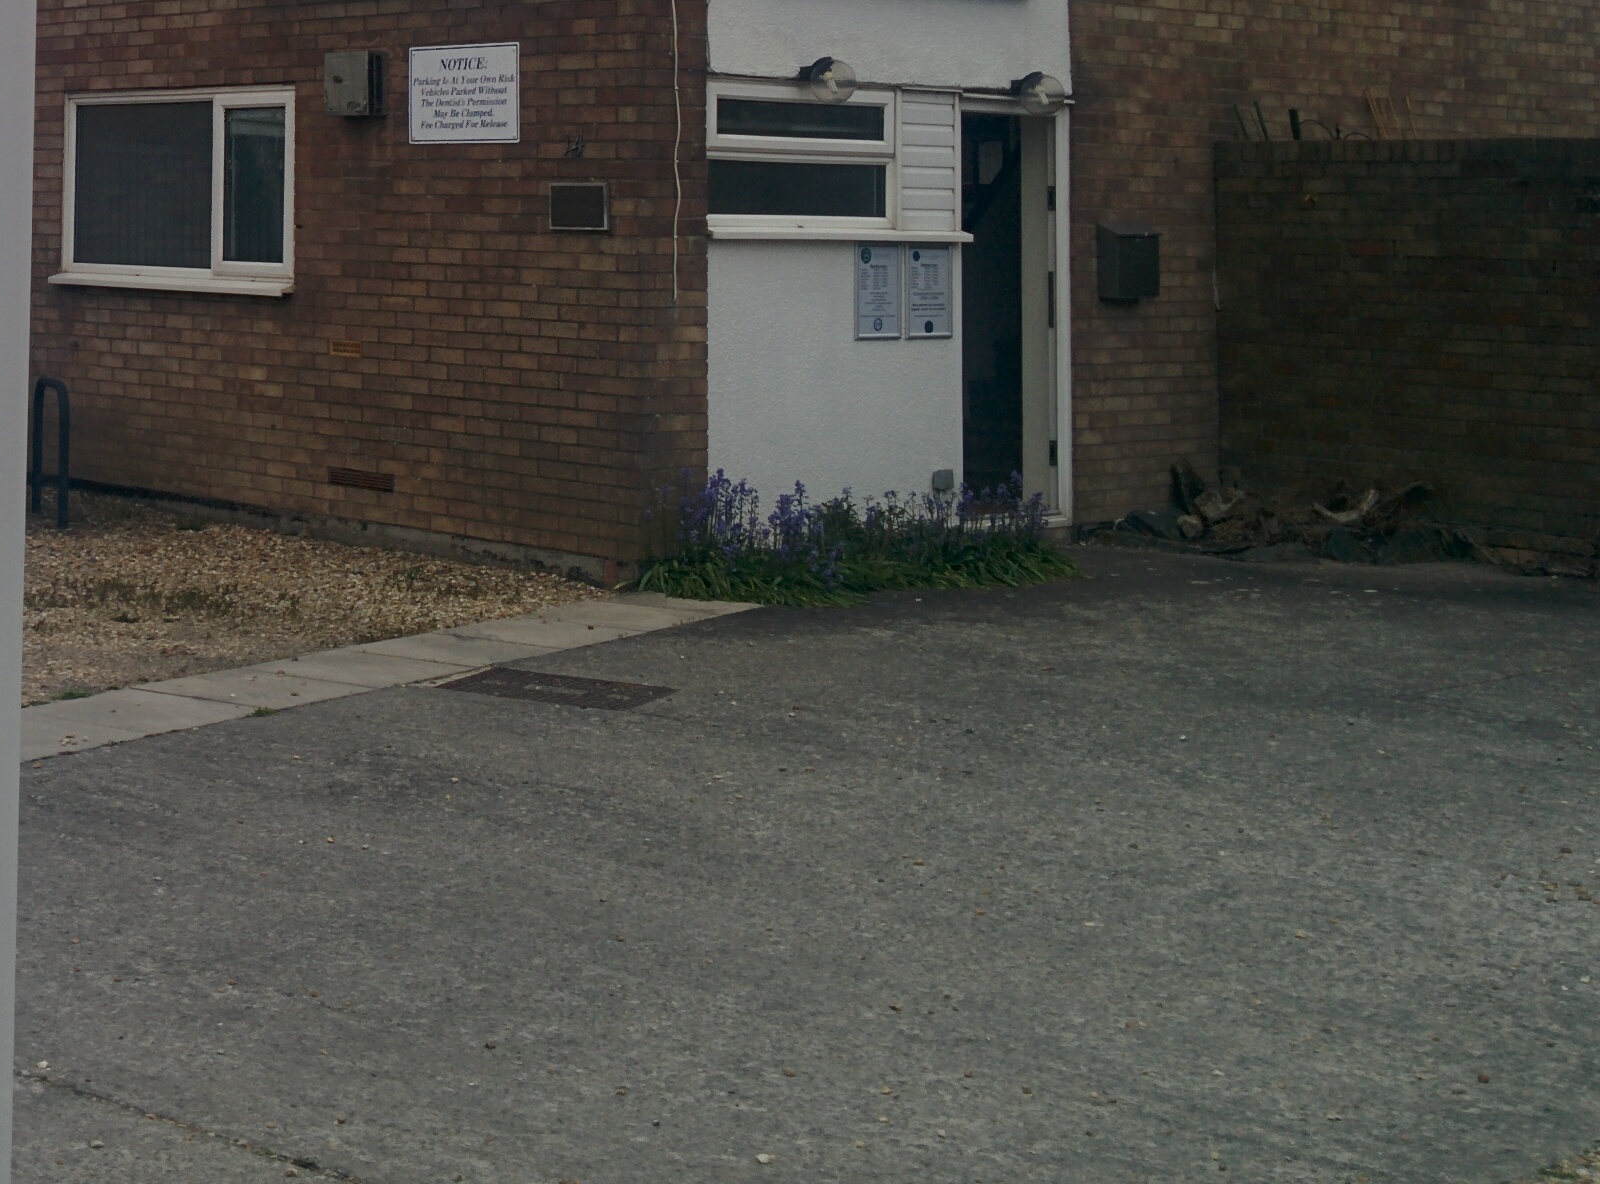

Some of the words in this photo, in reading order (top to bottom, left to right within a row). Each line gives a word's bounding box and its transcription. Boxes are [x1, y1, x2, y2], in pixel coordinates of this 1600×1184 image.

[439, 57, 488, 72] NOTICE:
[413, 77, 441, 86] Parking
[442, 76, 448, 85] Is
[450, 76, 458, 85] At
[461, 75, 479, 85] Your
[479, 75, 497, 83] Own
[498, 74, 516, 83] Risk
[421, 88, 450, 96] Vehicles
[450, 87, 477, 96] Parked
[478, 86, 508, 95] Without
[421, 99, 434, 107] The
[435, 98, 465, 107] Dentist's
[467, 97, 508, 106] Permission
[433, 109, 448, 119] May
[450, 109, 460, 118] Be
[420, 121, 434, 130] Fee
[434, 120, 464, 130] Charged
[465, 120, 478, 128] For
[479, 119, 508, 128] Release
